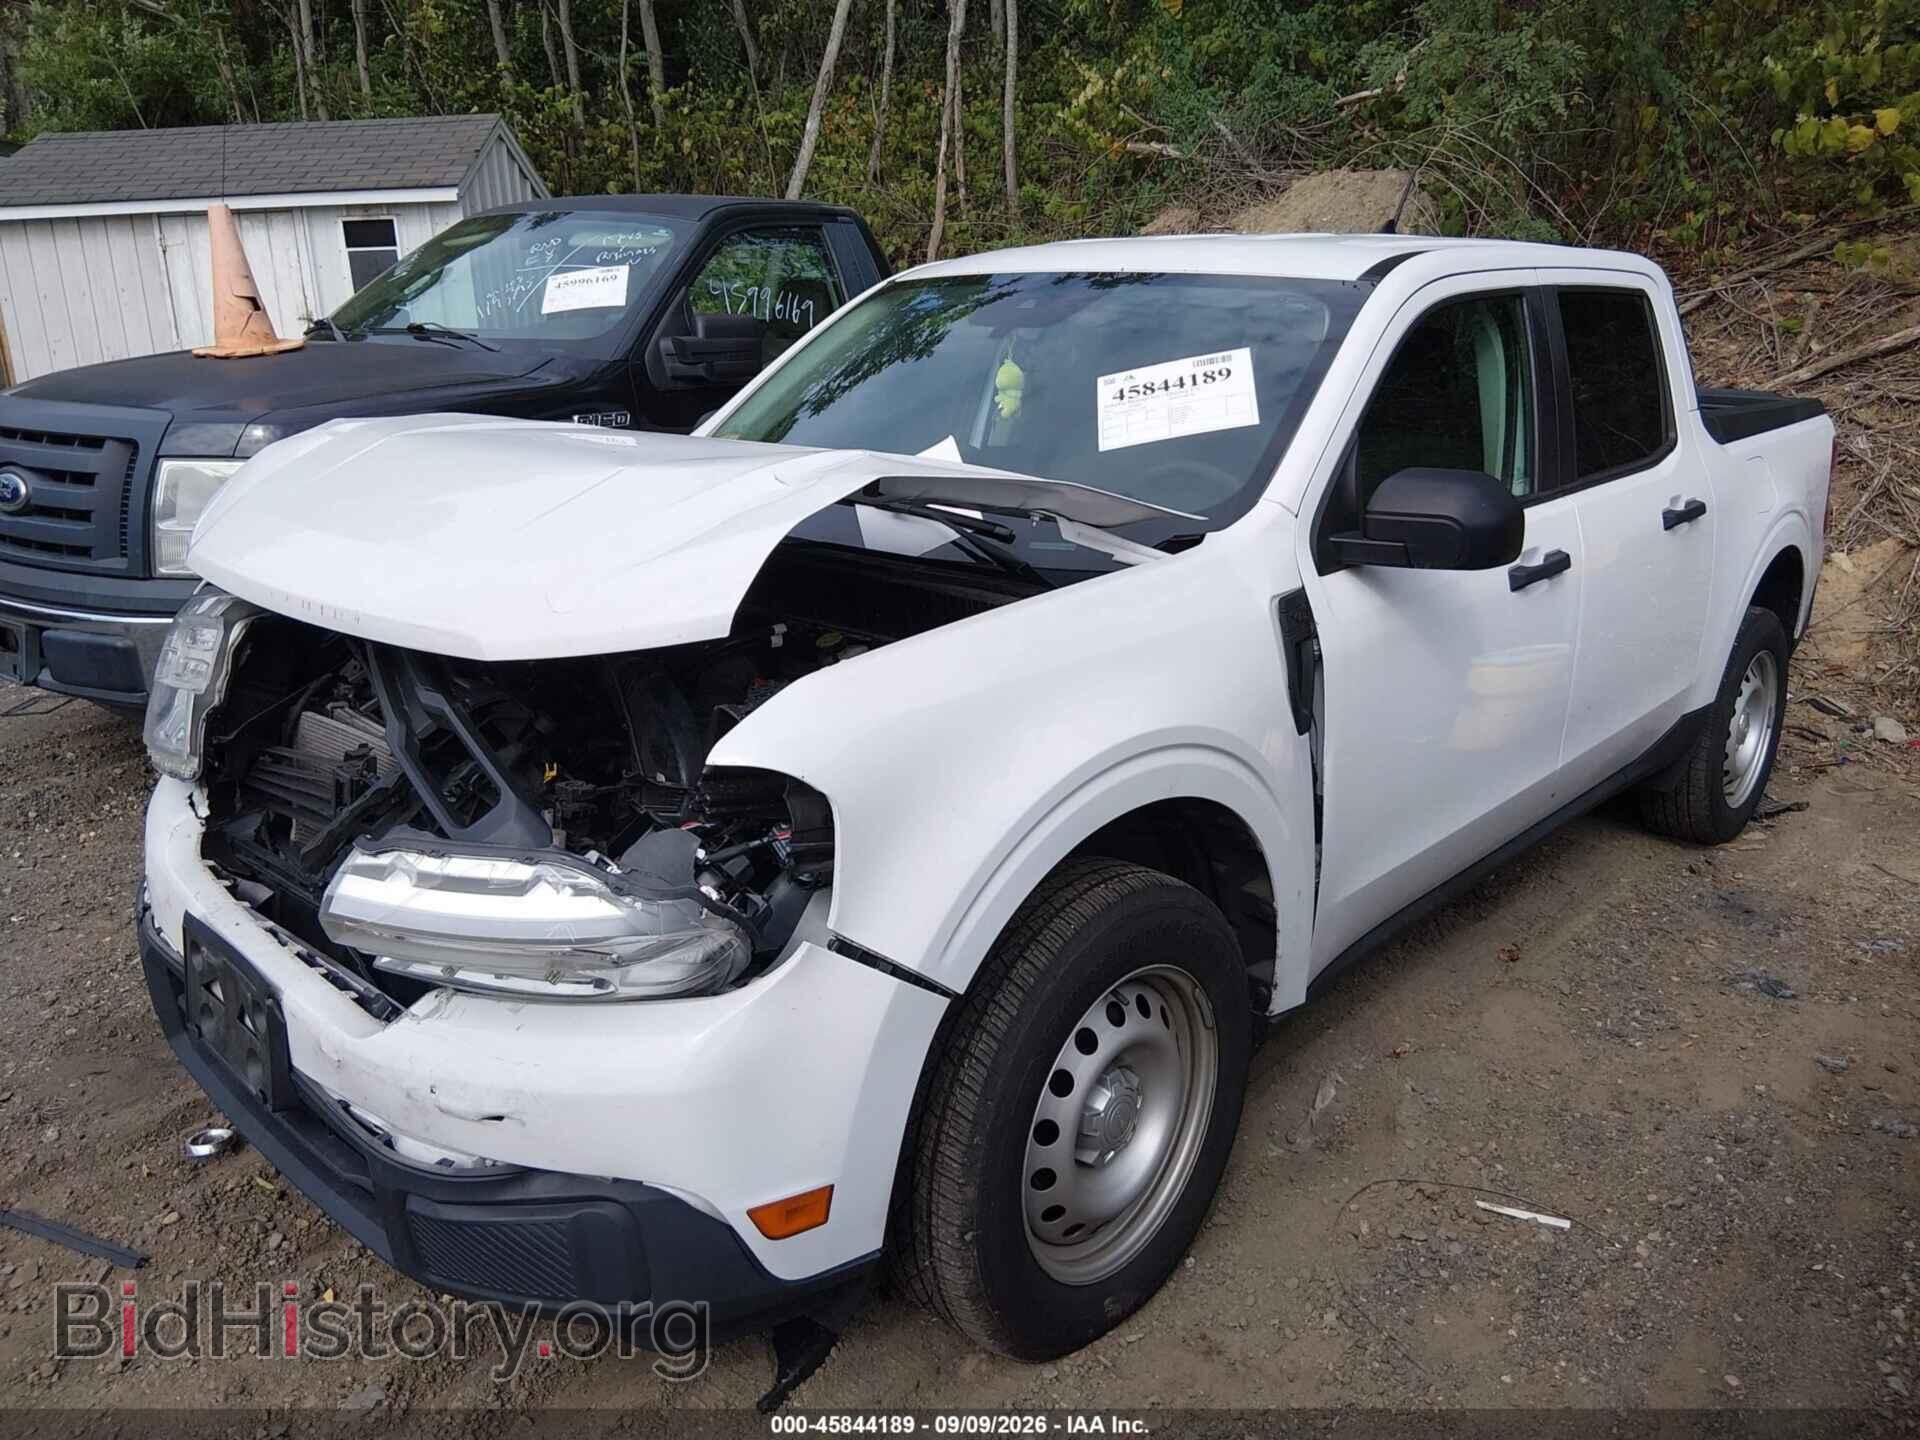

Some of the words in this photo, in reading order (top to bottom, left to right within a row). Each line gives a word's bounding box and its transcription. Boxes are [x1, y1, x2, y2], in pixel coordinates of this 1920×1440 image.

[554, 274, 618, 289] 45996169
[708, 277, 814, 329] 45996169
[1112, 367, 1232, 401] 45844189
